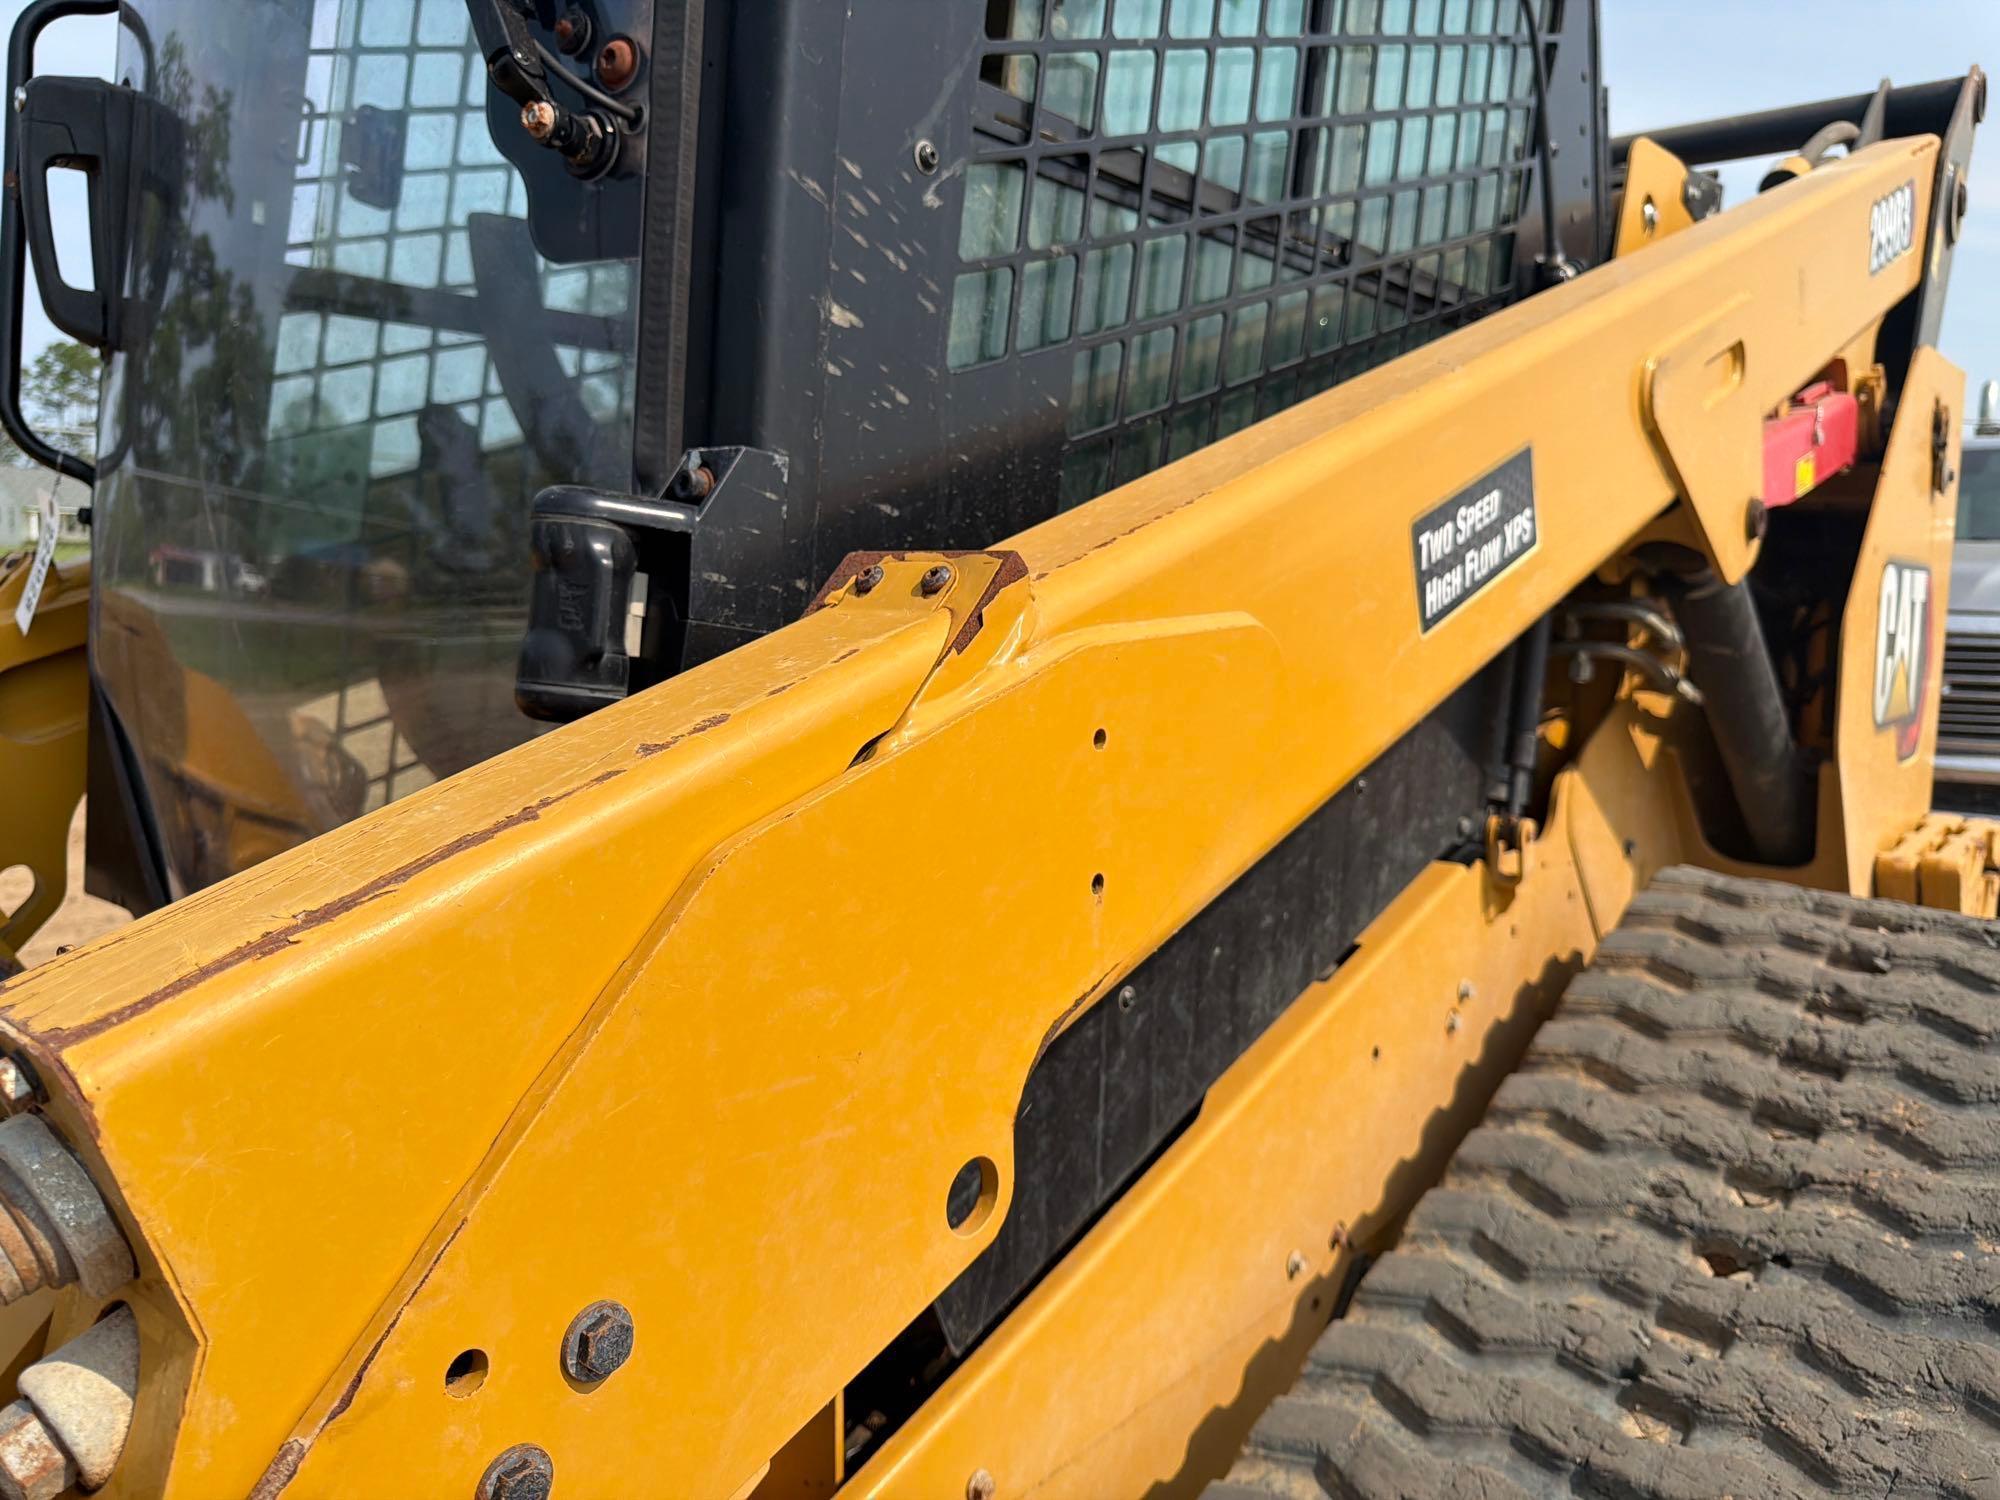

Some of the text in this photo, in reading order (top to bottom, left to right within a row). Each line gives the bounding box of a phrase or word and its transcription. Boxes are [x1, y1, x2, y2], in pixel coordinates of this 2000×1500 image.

[1419, 489, 1501, 571] TWO SPEED
[1425, 507, 1533, 618] HIGH FLOW XPS
[1874, 563, 1929, 725] CAT
